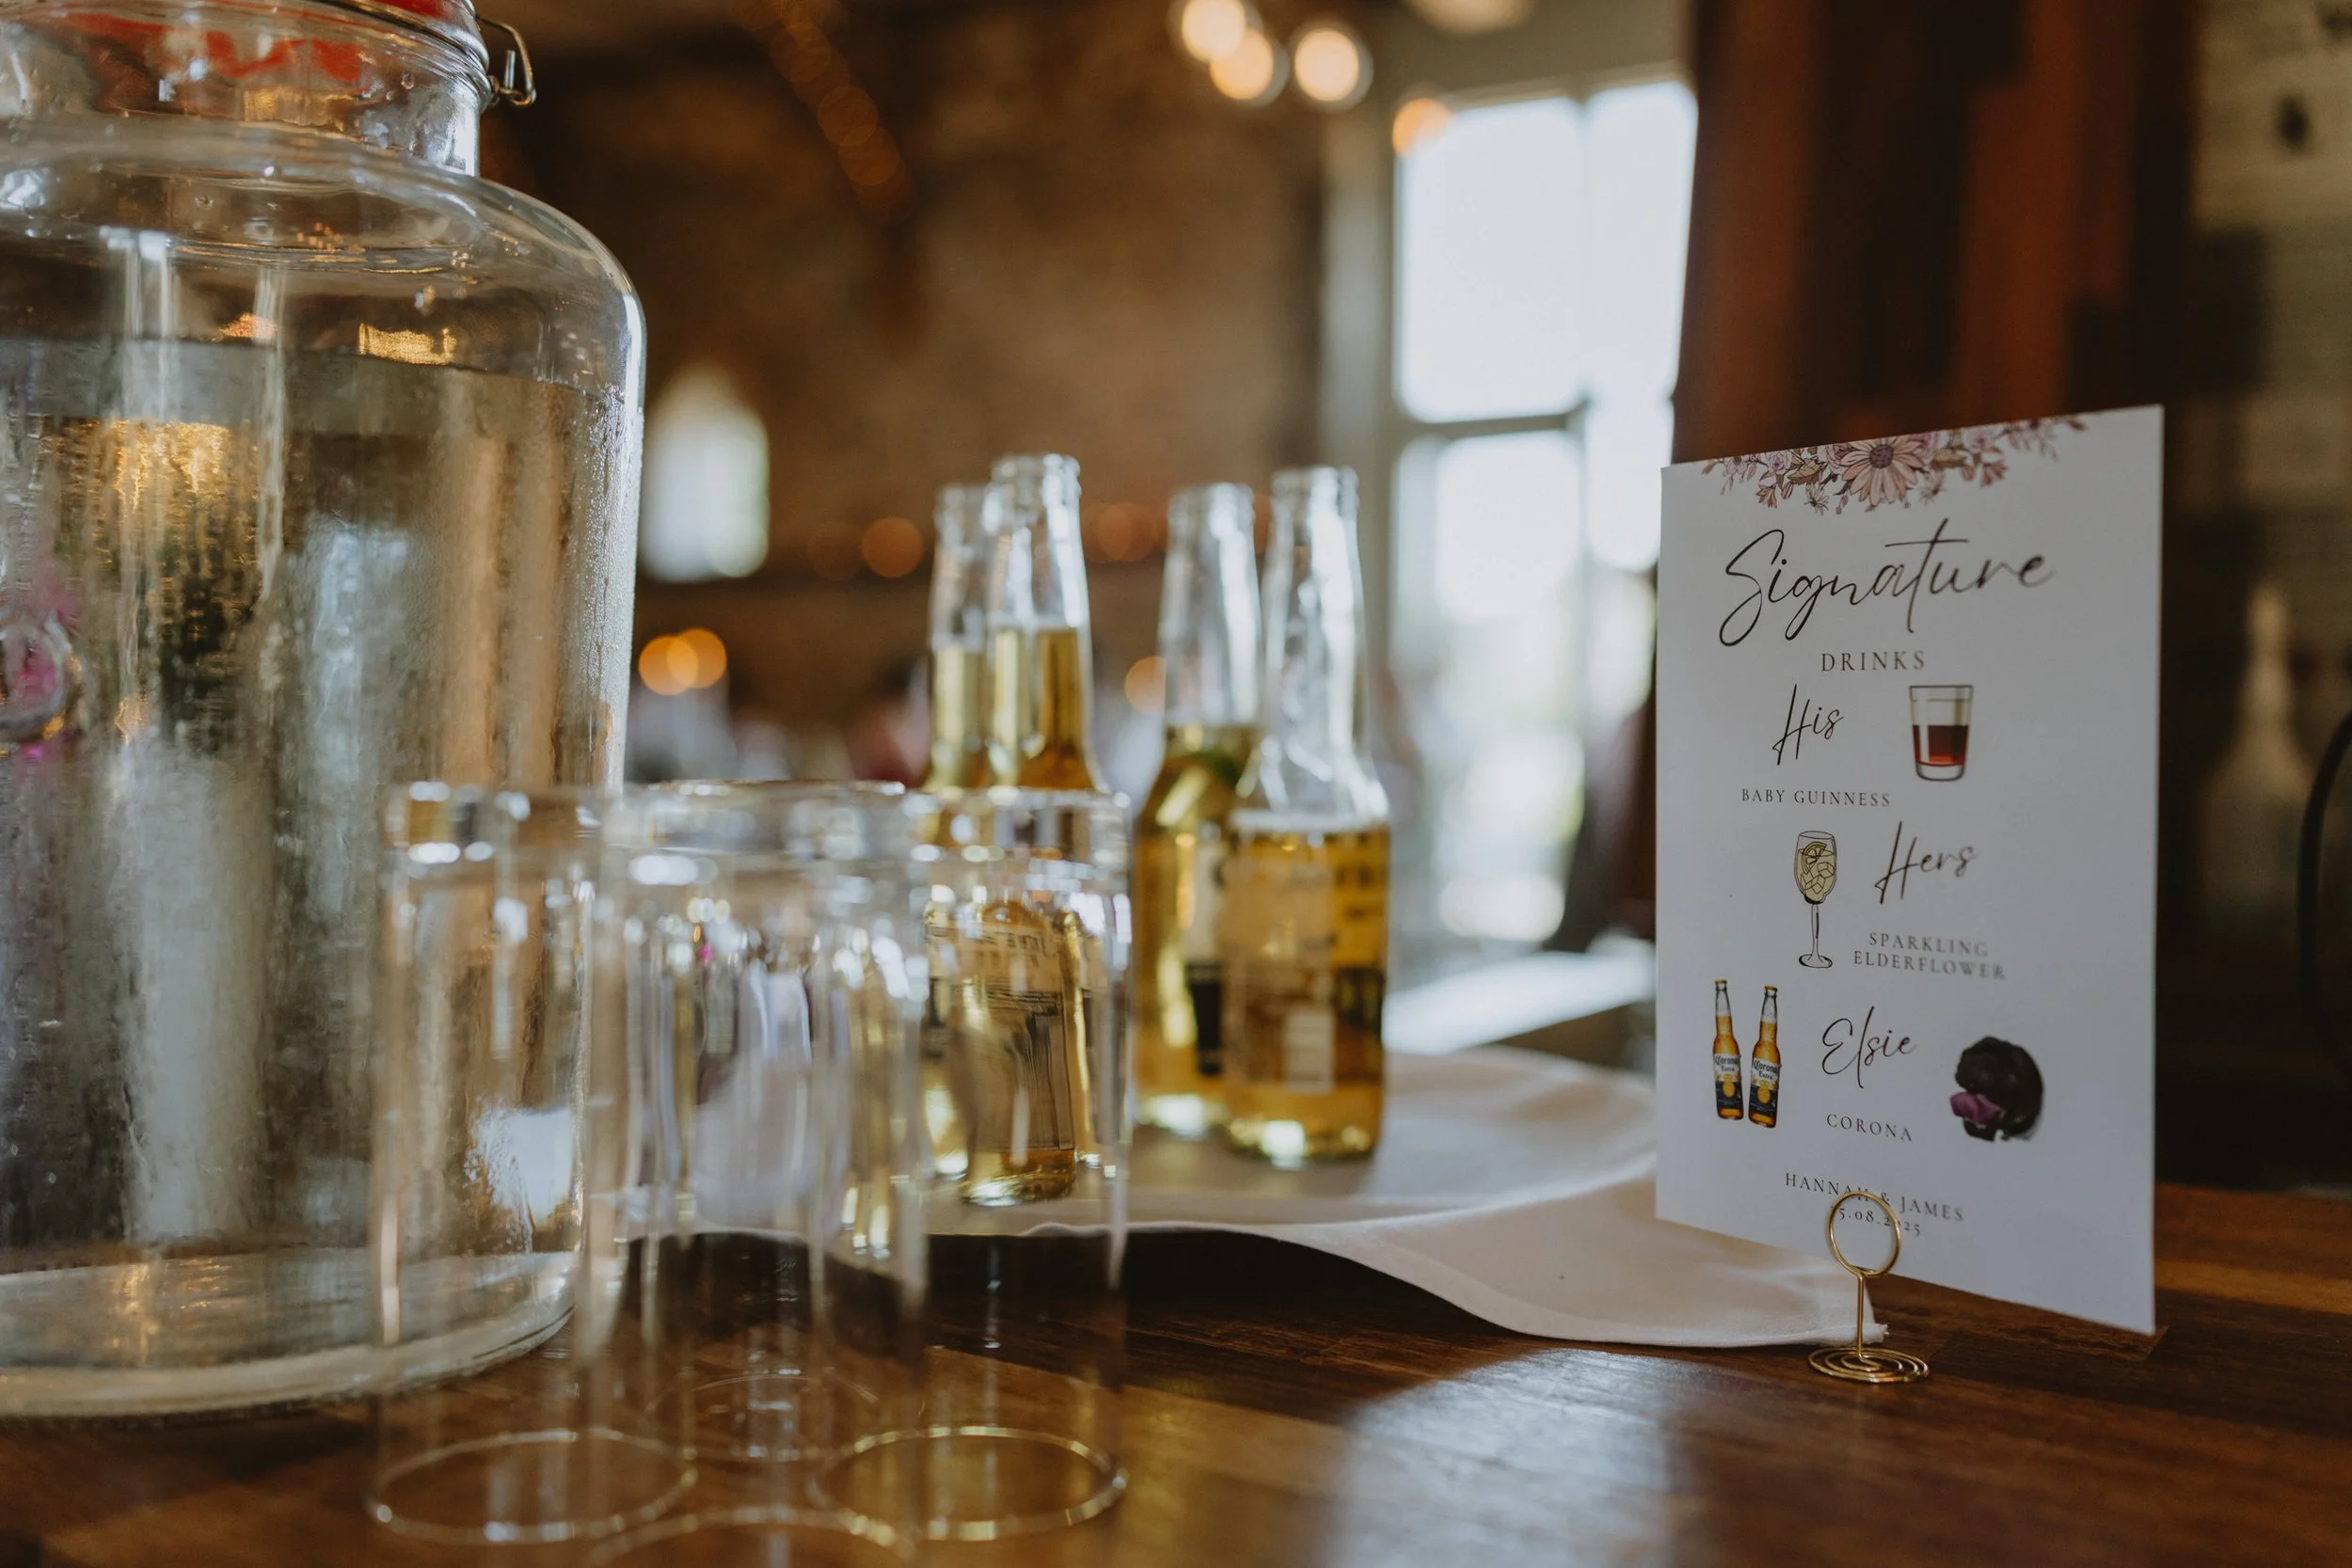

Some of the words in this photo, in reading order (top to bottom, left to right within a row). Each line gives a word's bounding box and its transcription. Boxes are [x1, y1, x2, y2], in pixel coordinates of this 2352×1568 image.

[1719, 517, 2057, 646] Signature
[1821, 651, 1926, 672] DRINKS
[1772, 684, 1844, 766] His
[1741, 788, 1785, 803] BABY
[1794, 790, 1890, 807] GUINNESS
[1875, 820, 1978, 904] Hers
[1868, 931, 1989, 957] SPARKLING
[1853, 950, 2007, 980] ELDERFLOWER
[1716, 1055, 1739, 1065] Corona
[1822, 1006, 1918, 1089] Elsie
[1753, 1060, 1778, 1073] Corona
[1826, 1114, 1914, 1142] CORONA
[1830, 1205, 1920, 1237] 5.08.225
[1899, 1196, 1964, 1222] JAMES
